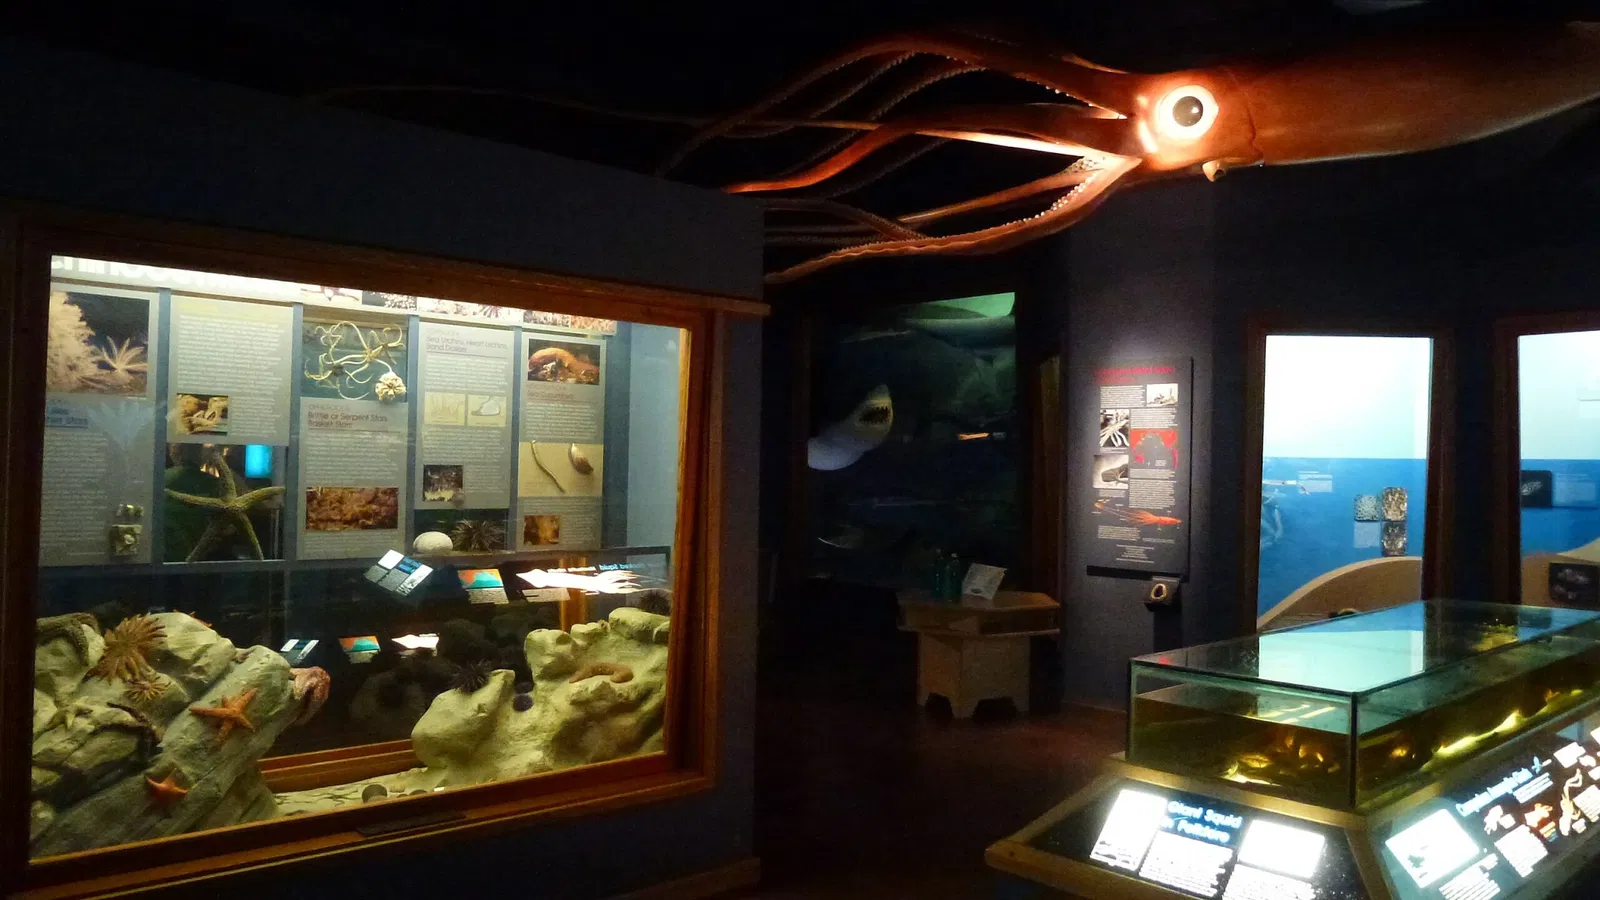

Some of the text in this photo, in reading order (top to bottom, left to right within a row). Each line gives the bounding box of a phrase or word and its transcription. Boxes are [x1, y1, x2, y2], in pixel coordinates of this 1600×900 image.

[307, 411, 329, 420] Brittle
[340, 412, 369, 422] Serpent
[371, 413, 388, 422] Stars
[1168, 801, 1243, 828] Giant Squid
